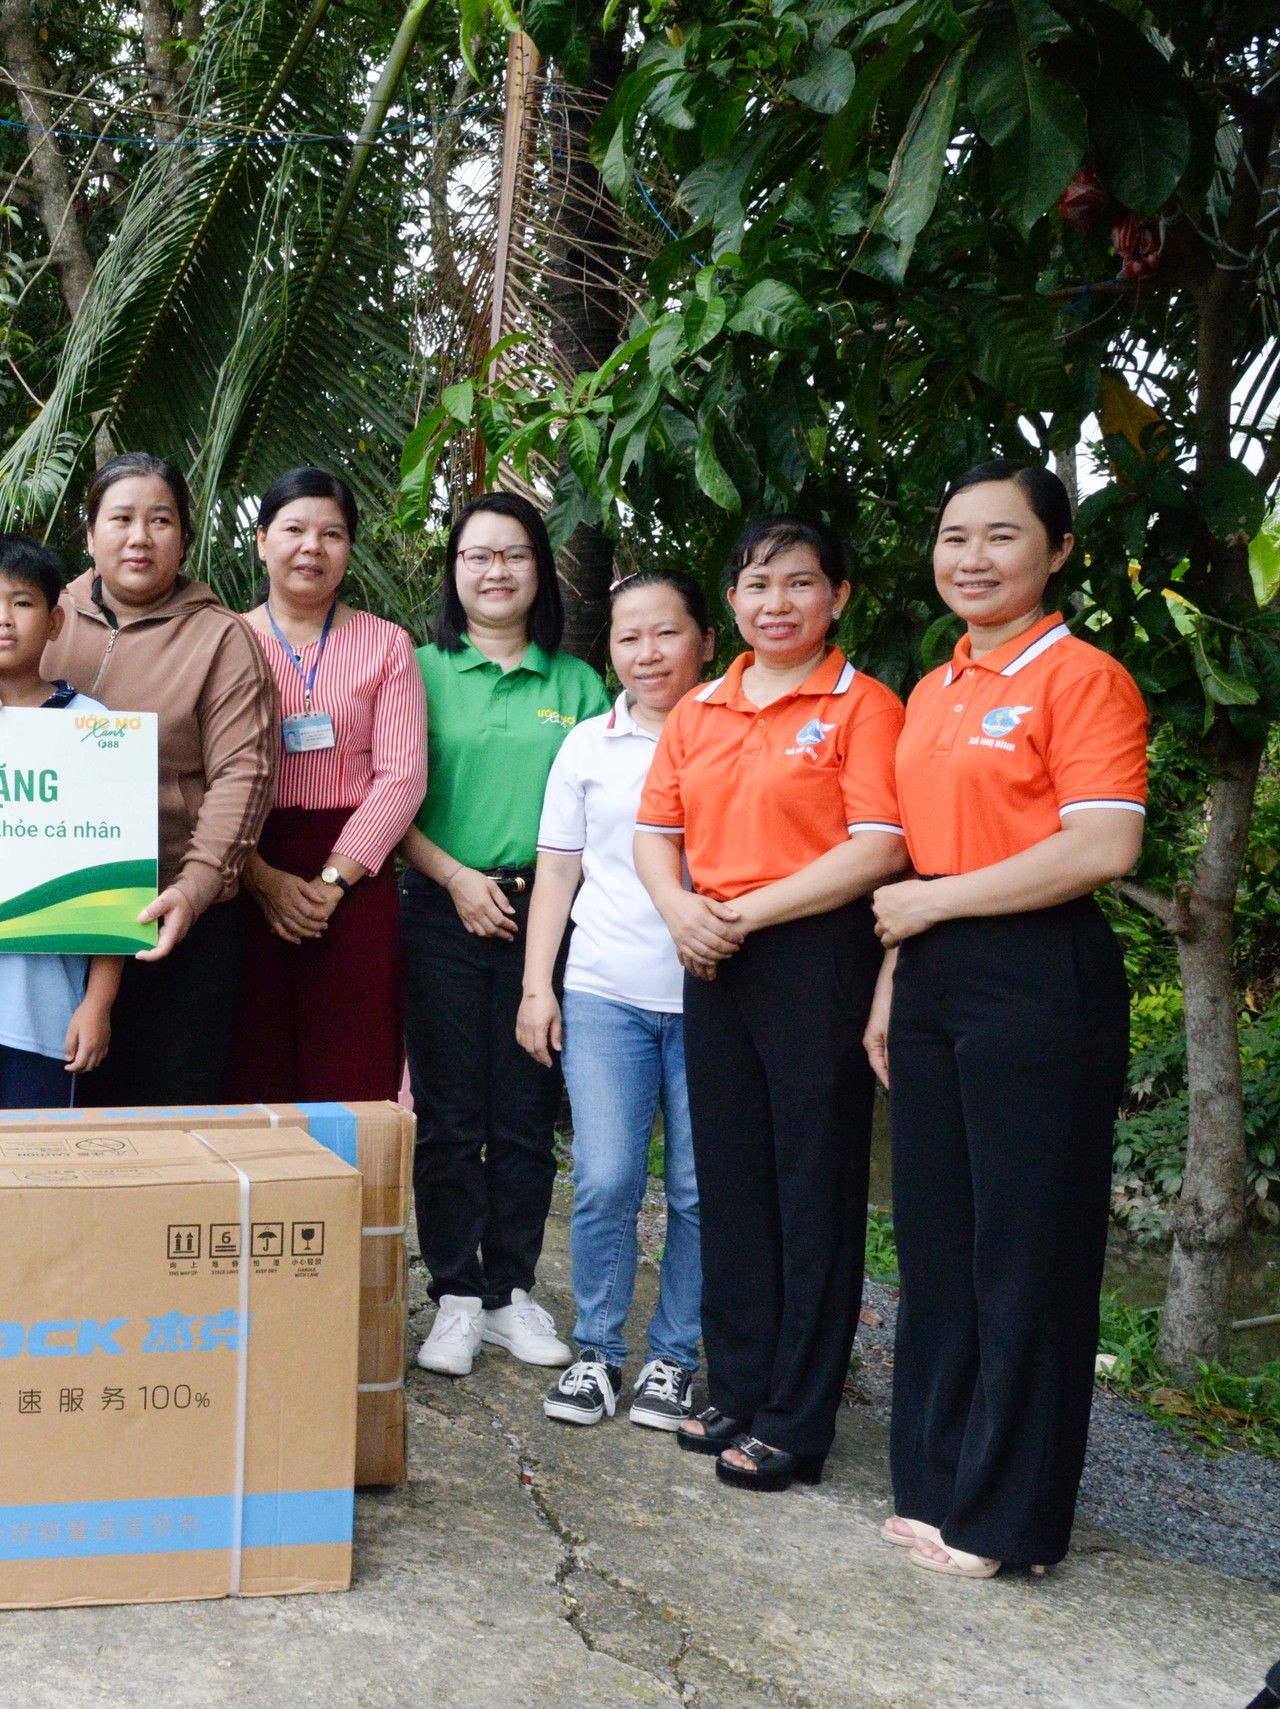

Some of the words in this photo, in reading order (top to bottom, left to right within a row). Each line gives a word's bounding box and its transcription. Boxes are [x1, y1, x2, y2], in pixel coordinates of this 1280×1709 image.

[80, 720, 126, 742] Xanh
[44, 820, 67, 838] cá
[73, 820, 121, 839] nhân
[221, 1231, 232, 1244] 6
